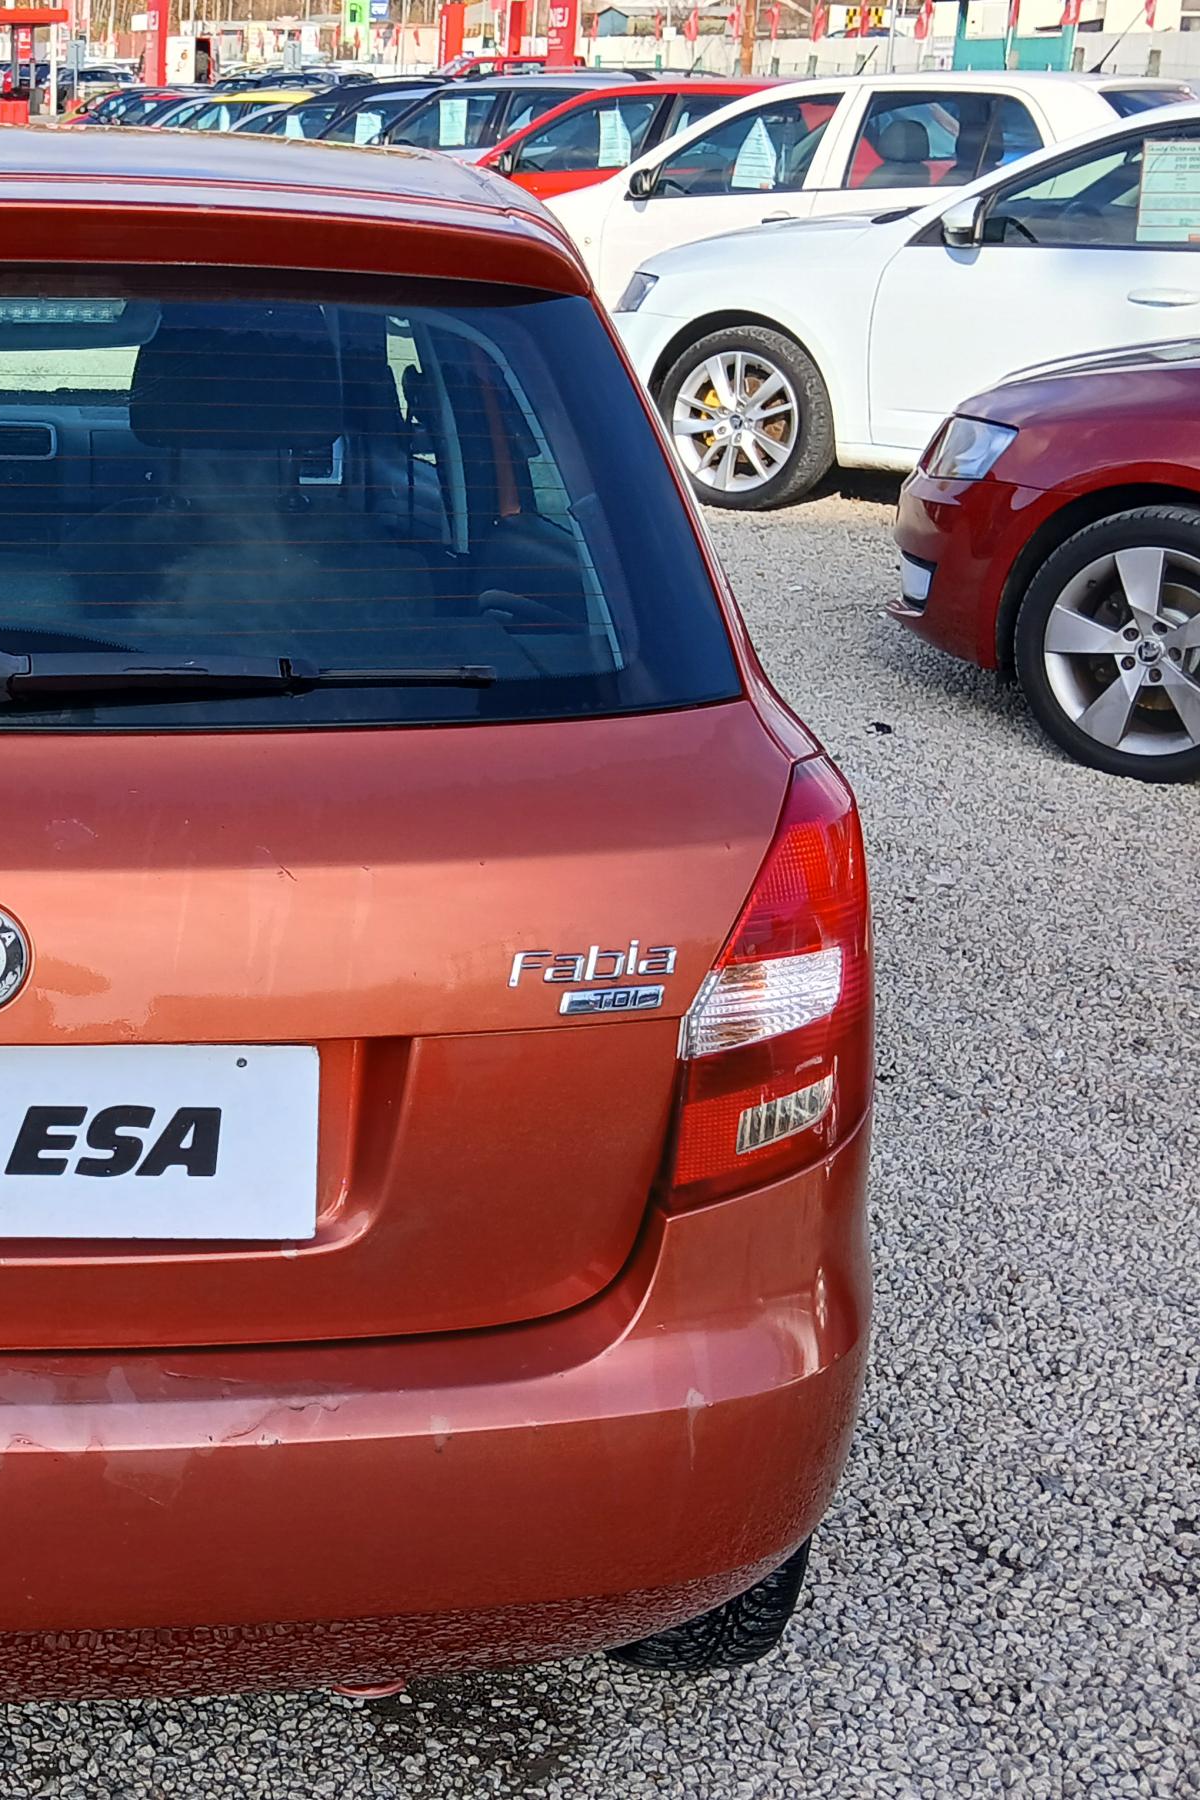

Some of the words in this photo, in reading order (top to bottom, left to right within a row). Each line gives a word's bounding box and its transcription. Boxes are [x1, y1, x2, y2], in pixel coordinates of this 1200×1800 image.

[508, 939, 678, 988] Fabia
[594, 990, 639, 1009] TDI
[5, 1105, 223, 1178] ESA
